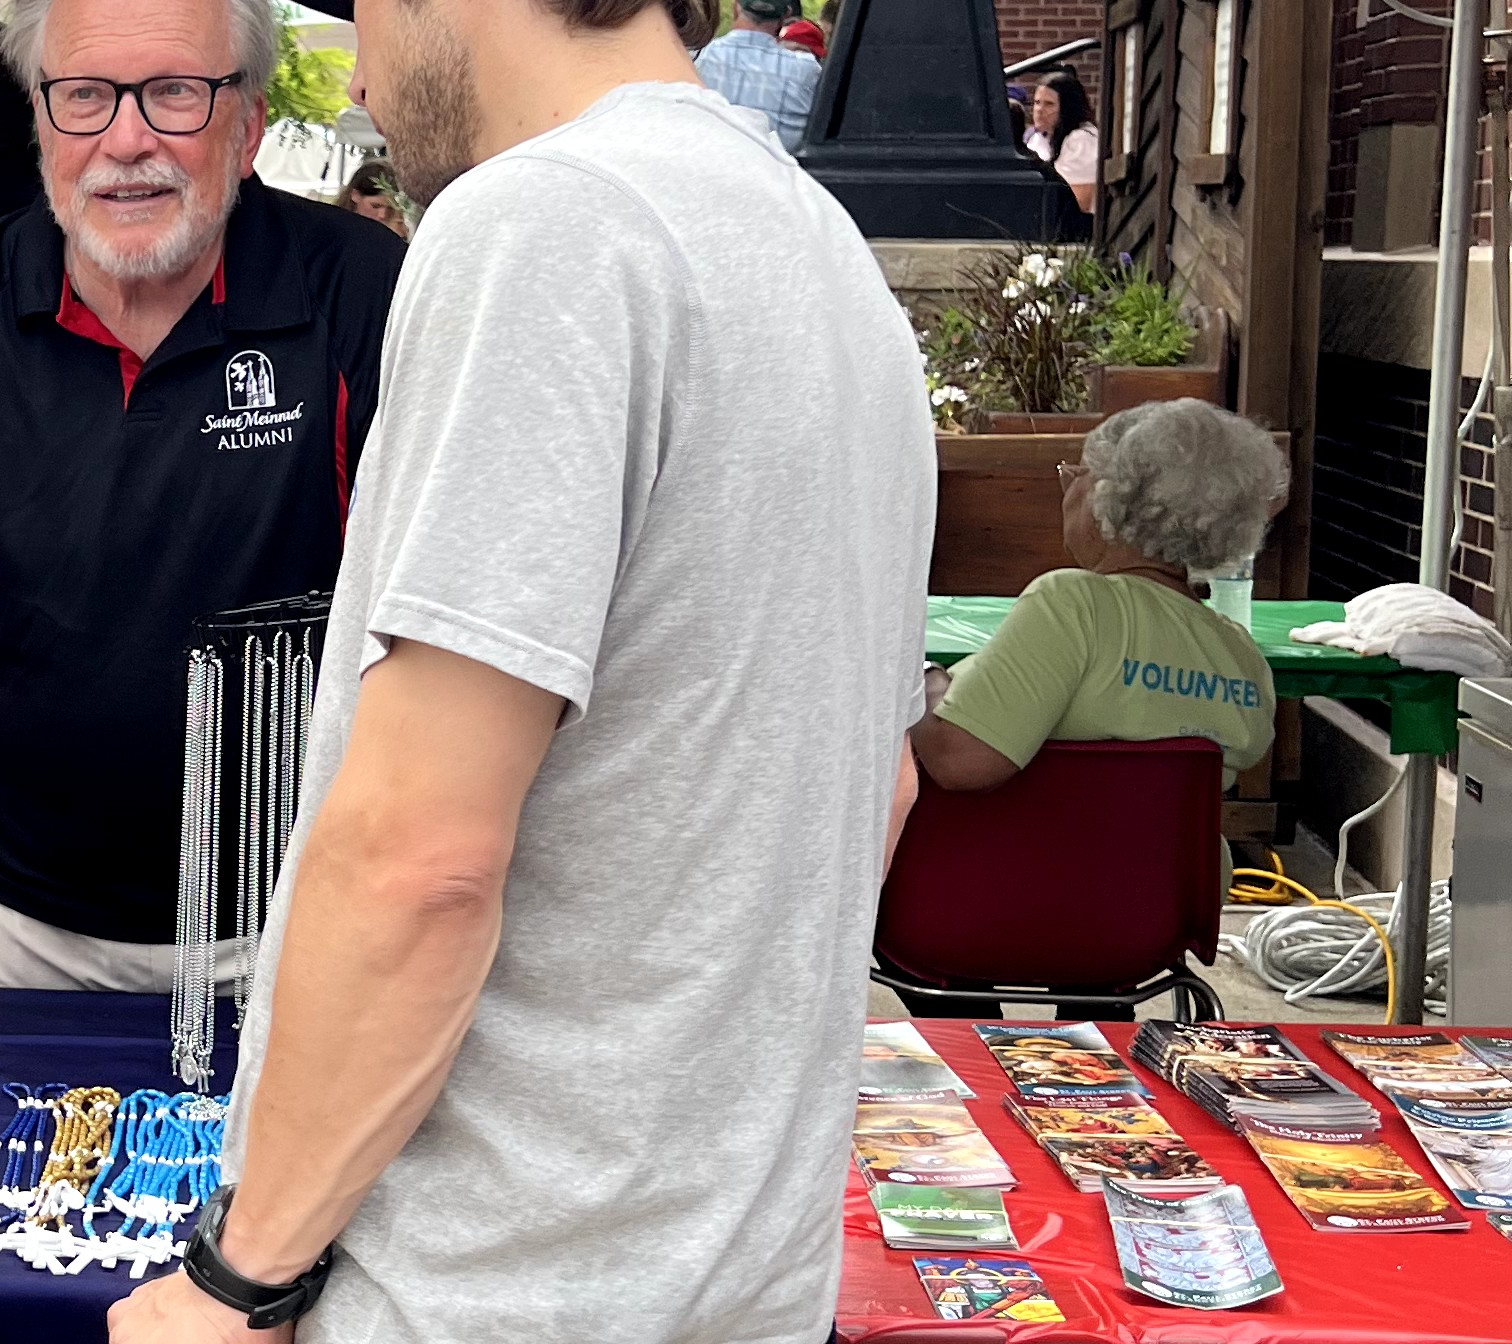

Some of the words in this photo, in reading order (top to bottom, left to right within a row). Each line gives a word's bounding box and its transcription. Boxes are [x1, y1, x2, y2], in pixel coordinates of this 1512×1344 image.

[200, 412, 242, 434] Saint
[217, 427, 293, 451] ALUMNI
[1249, 1117, 1275, 1131] The
[1278, 1126, 1312, 1139] Holy
[1312, 1131, 1363, 1140] Trinity
